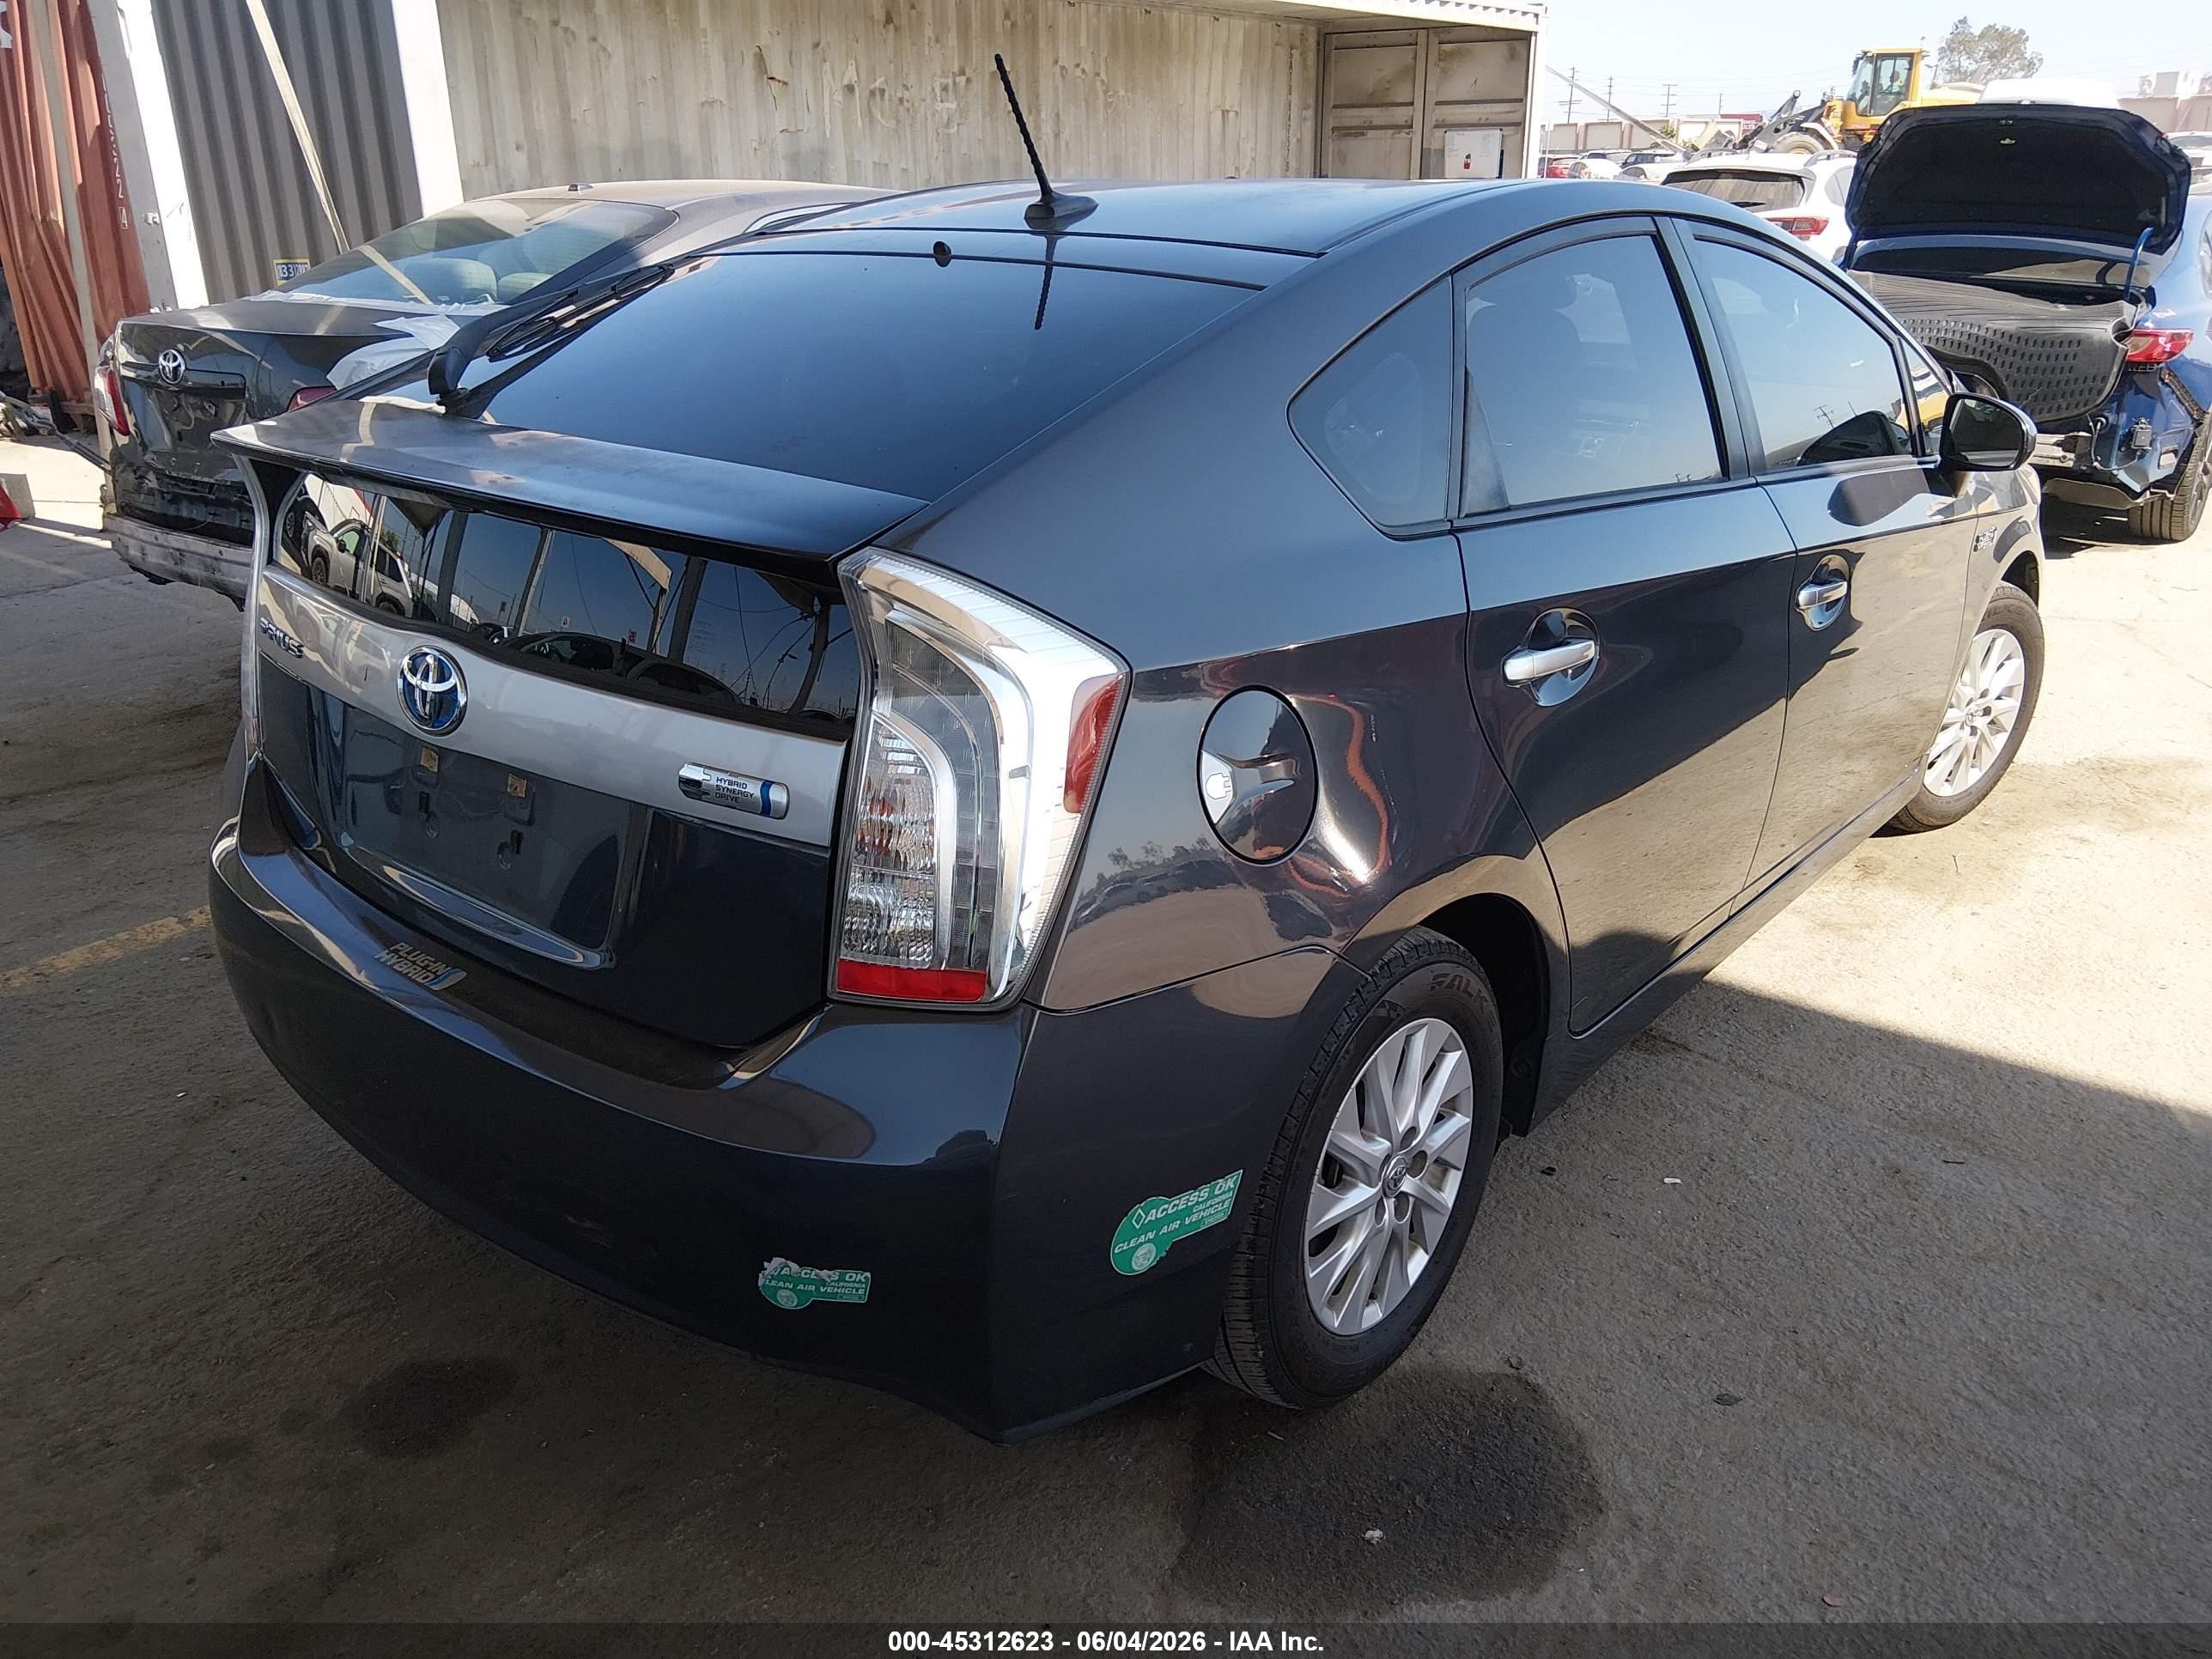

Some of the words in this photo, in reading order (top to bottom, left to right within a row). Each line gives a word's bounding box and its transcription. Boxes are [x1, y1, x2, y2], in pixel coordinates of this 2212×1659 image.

[716, 776, 748, 790] HYBRID
[714, 792, 742, 804] DRIVE
[715, 784, 755, 799] SYNERGY
[374, 950, 436, 984] HYBRID
[1144, 1188, 1210, 1224] ACCESS
[1214, 1176, 1238, 1194] OK
[1193, 1191, 1233, 1213] CALIFORNIA
[1114, 1230, 1157, 1254] CLEAN
[1159, 1220, 1181, 1235] AIR
[1185, 1199, 1231, 1224] VEHICLE
[845, 1273, 866, 1283] OK
[820, 1285, 866, 1295] VEHICLE
